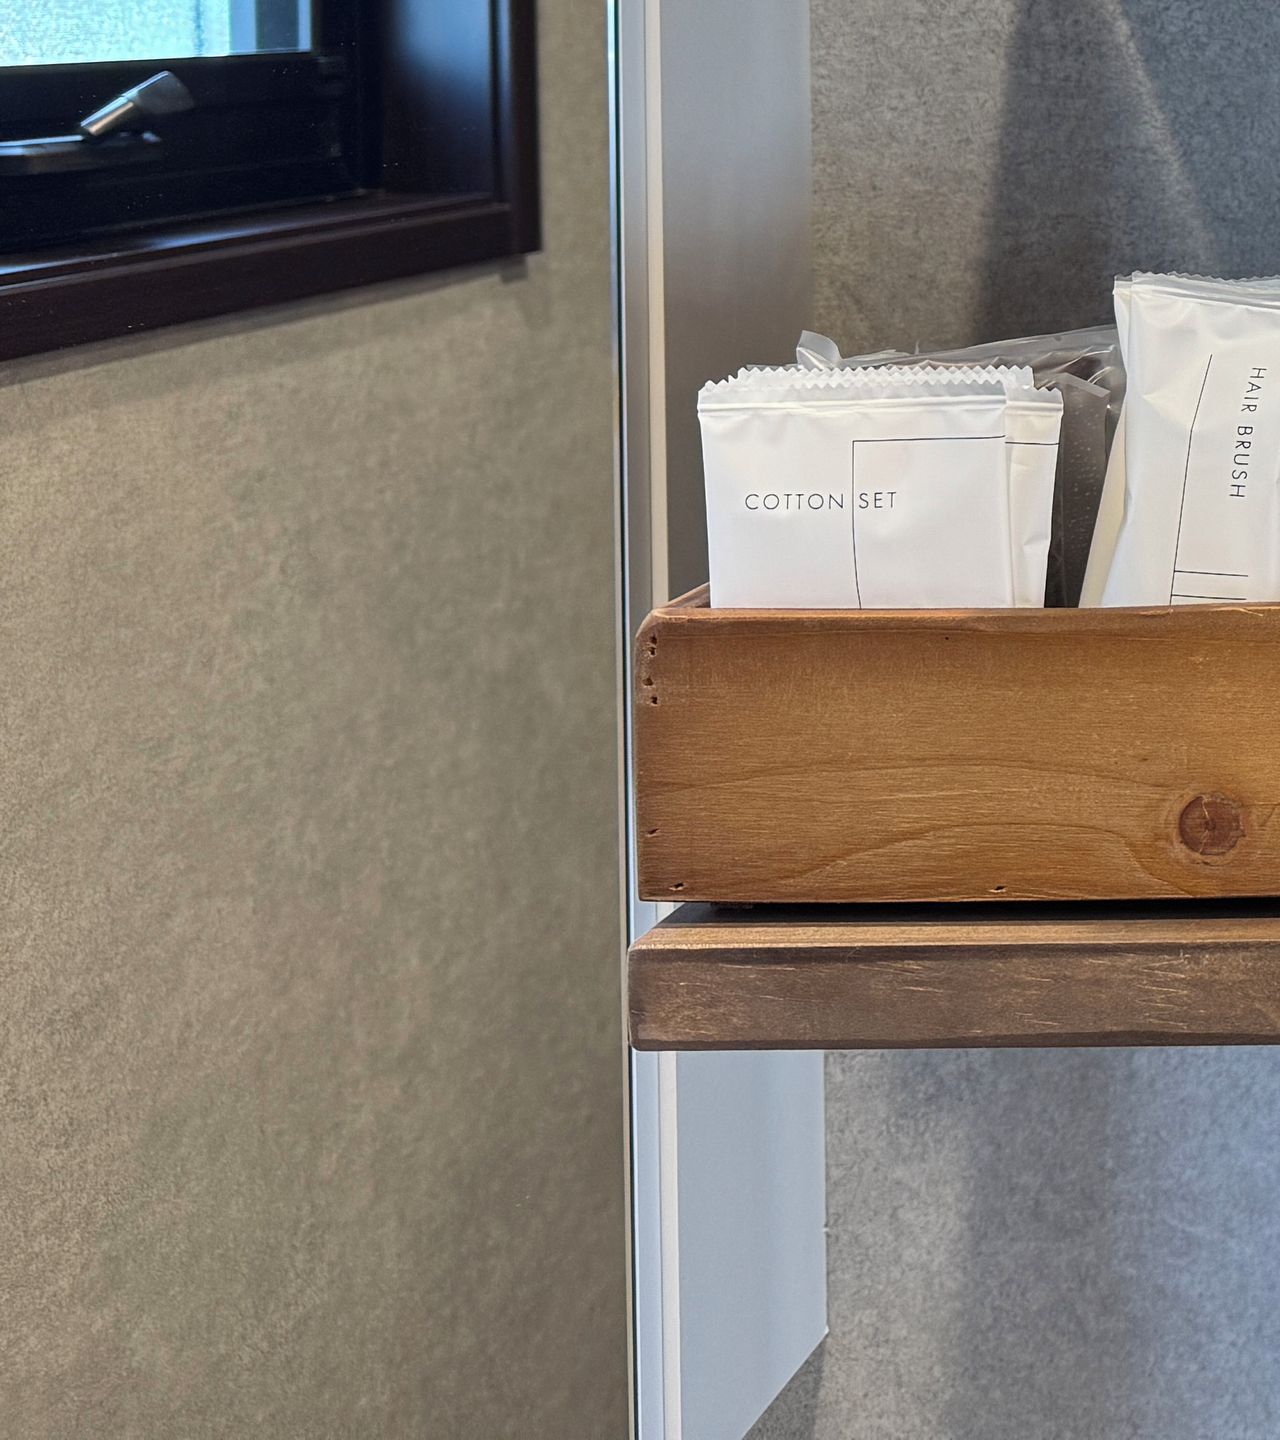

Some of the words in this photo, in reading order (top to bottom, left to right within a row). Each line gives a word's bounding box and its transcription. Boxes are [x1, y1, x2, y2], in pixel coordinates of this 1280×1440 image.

[1240, 367, 1267, 412] HAIR
[1229, 426, 1254, 497] BRUSH
[744, 493, 844, 510] COTTON
[858, 491, 897, 509] SET
